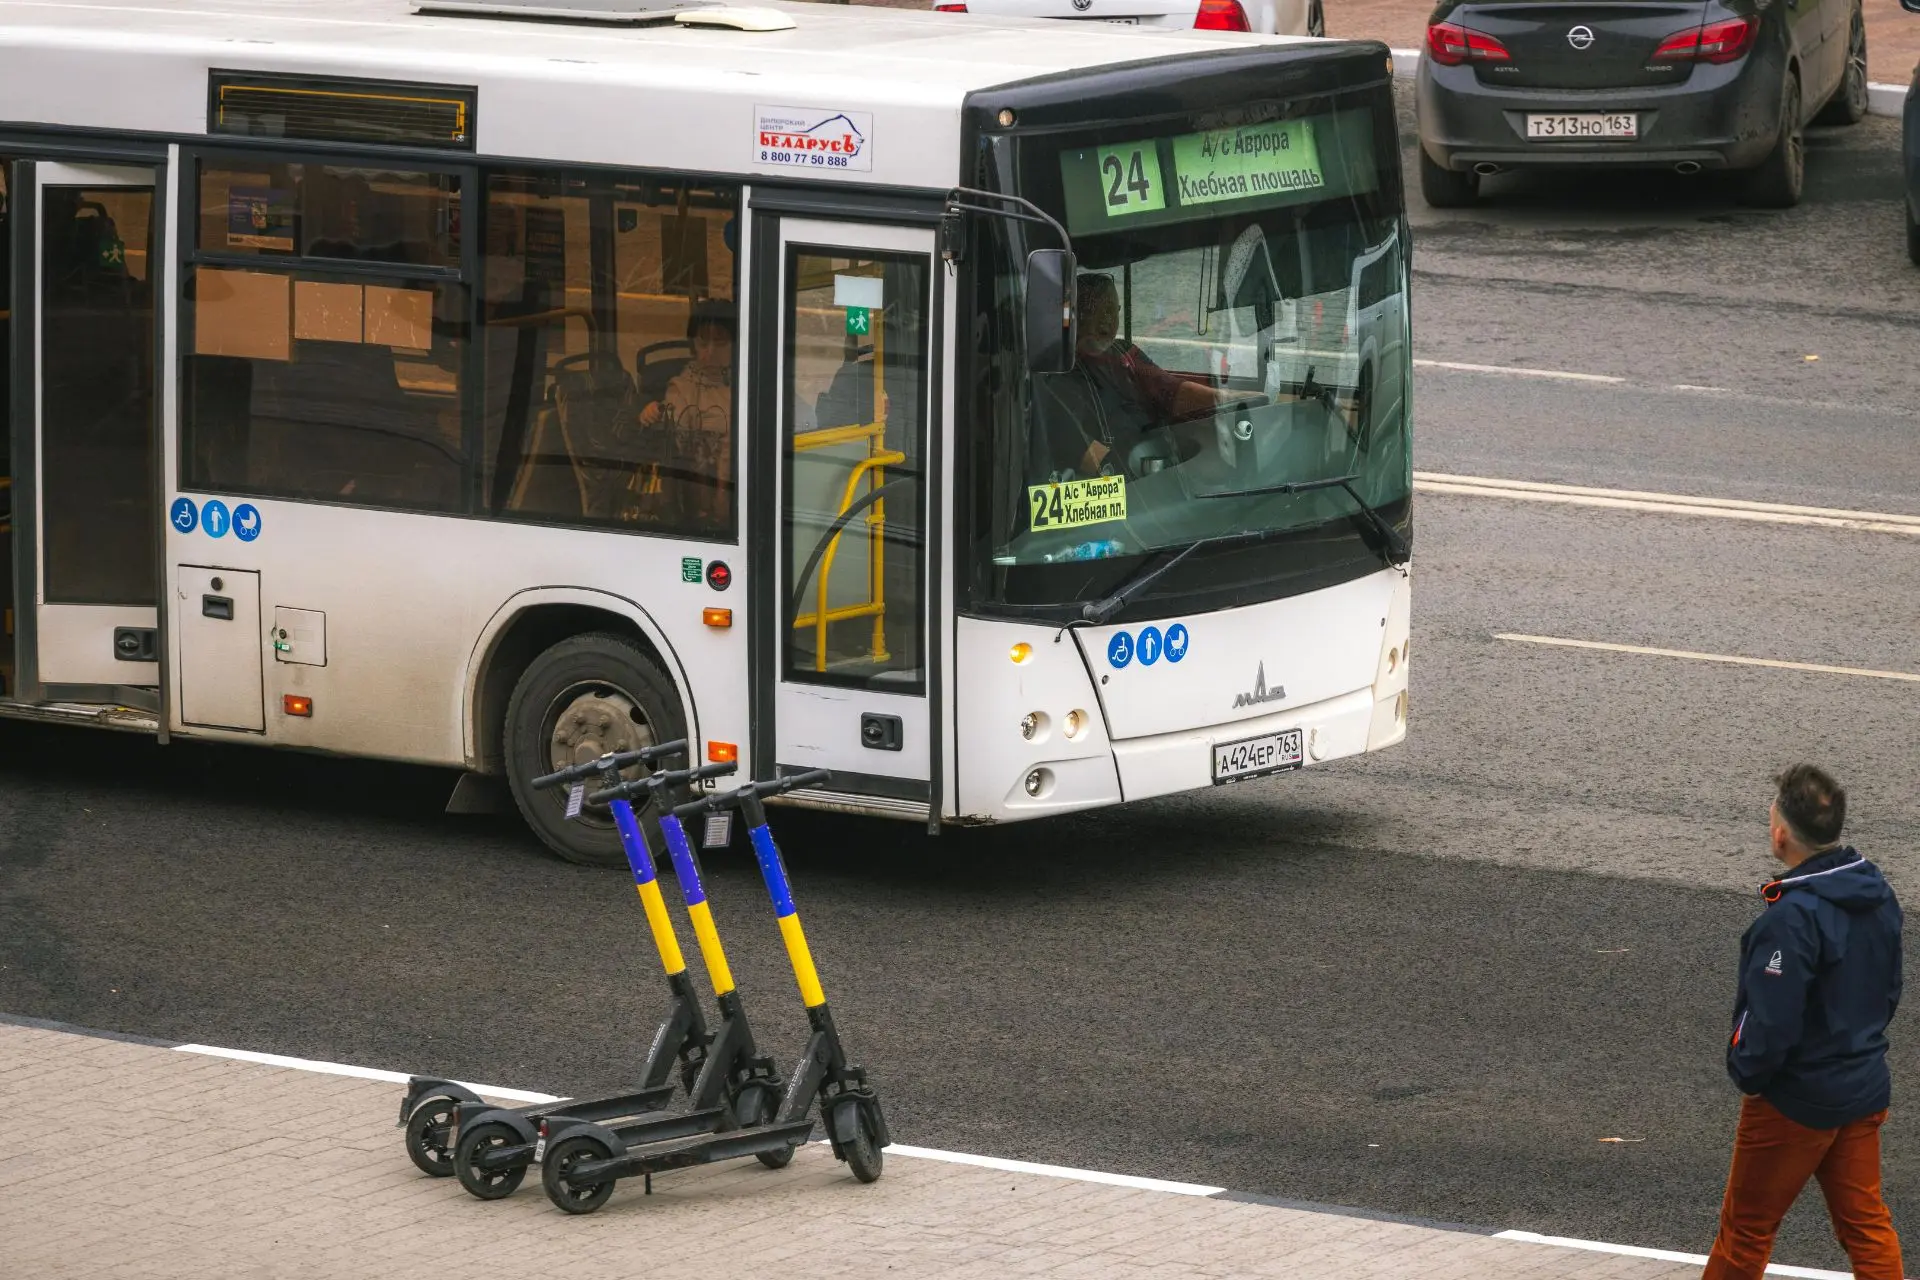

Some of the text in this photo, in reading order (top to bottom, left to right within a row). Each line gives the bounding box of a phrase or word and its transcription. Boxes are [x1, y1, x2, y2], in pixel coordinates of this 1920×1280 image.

[761, 151, 848, 167] 8 800 77 50 888
[1201, 130, 1290, 162] А/с Аврора
[1102, 151, 1149, 207] 24
[1179, 167, 1321, 200] Хлебная площадь
[1064, 477, 1123, 500] А/с "Аврора"
[1033, 486, 1064, 527] 24
[1065, 501, 1125, 523] Хлебная пл.
